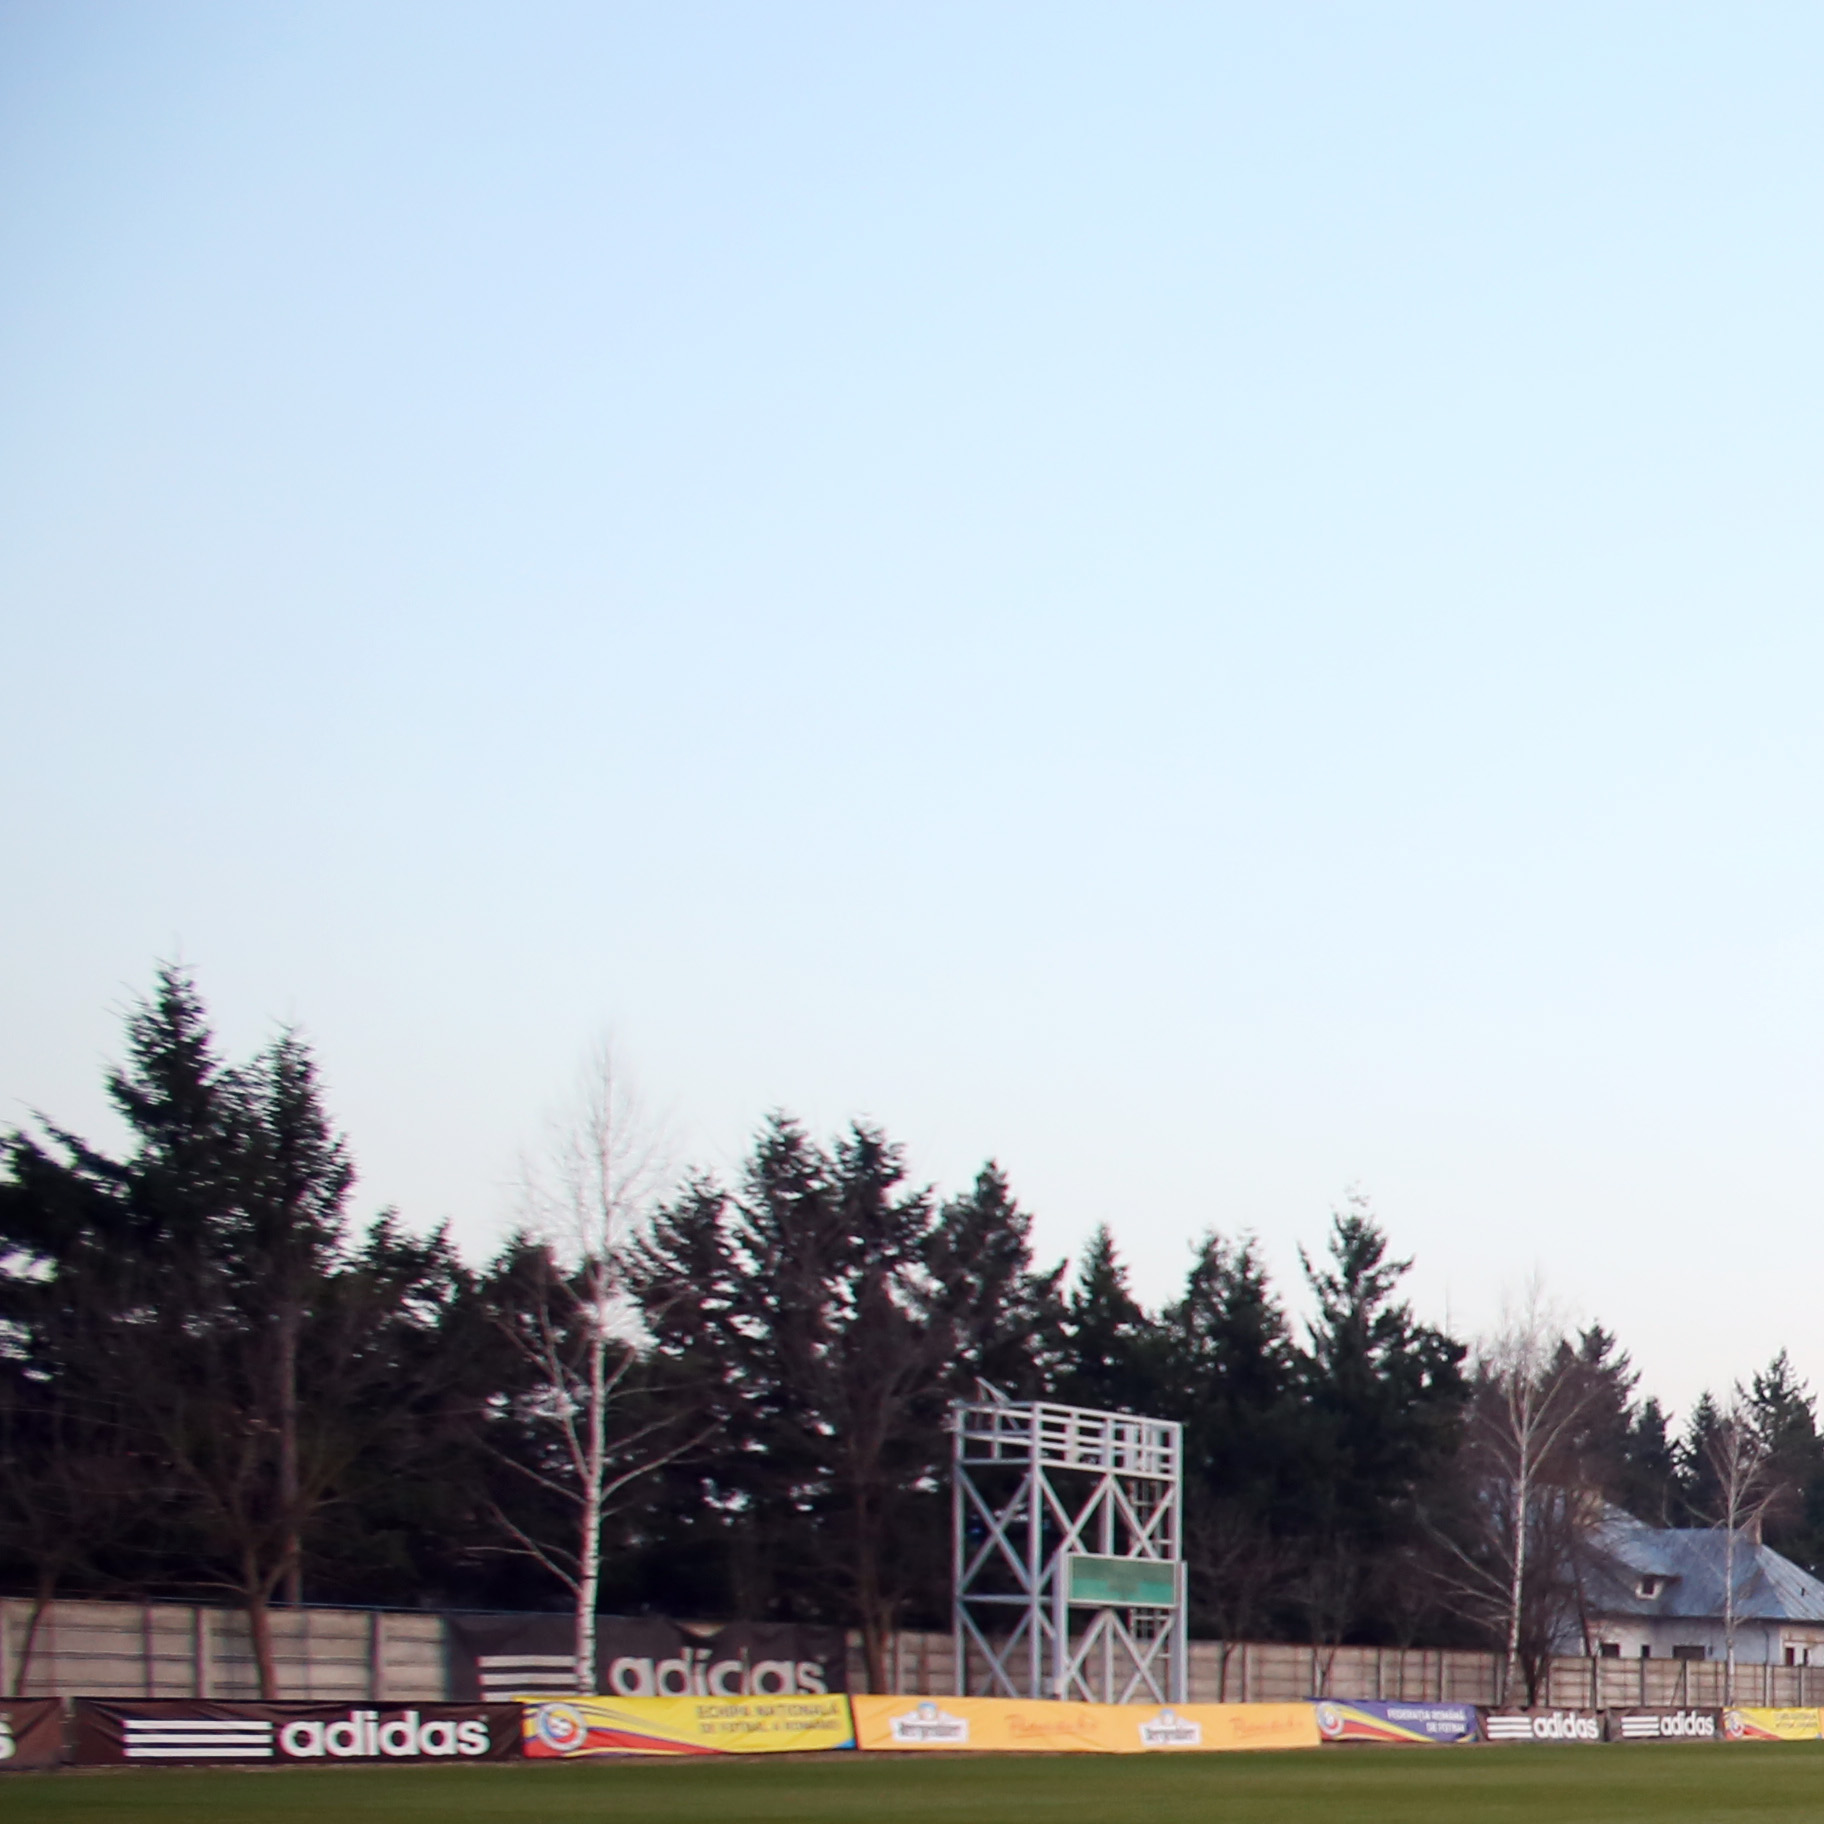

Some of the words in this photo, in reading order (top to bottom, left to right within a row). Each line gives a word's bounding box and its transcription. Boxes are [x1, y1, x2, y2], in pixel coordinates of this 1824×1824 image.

[608, 1646, 829, 1697] adidas
[280, 1710, 491, 1757] adidas
[1533, 1711, 1599, 1739] adidas
[1660, 1710, 1715, 1736] adidas
